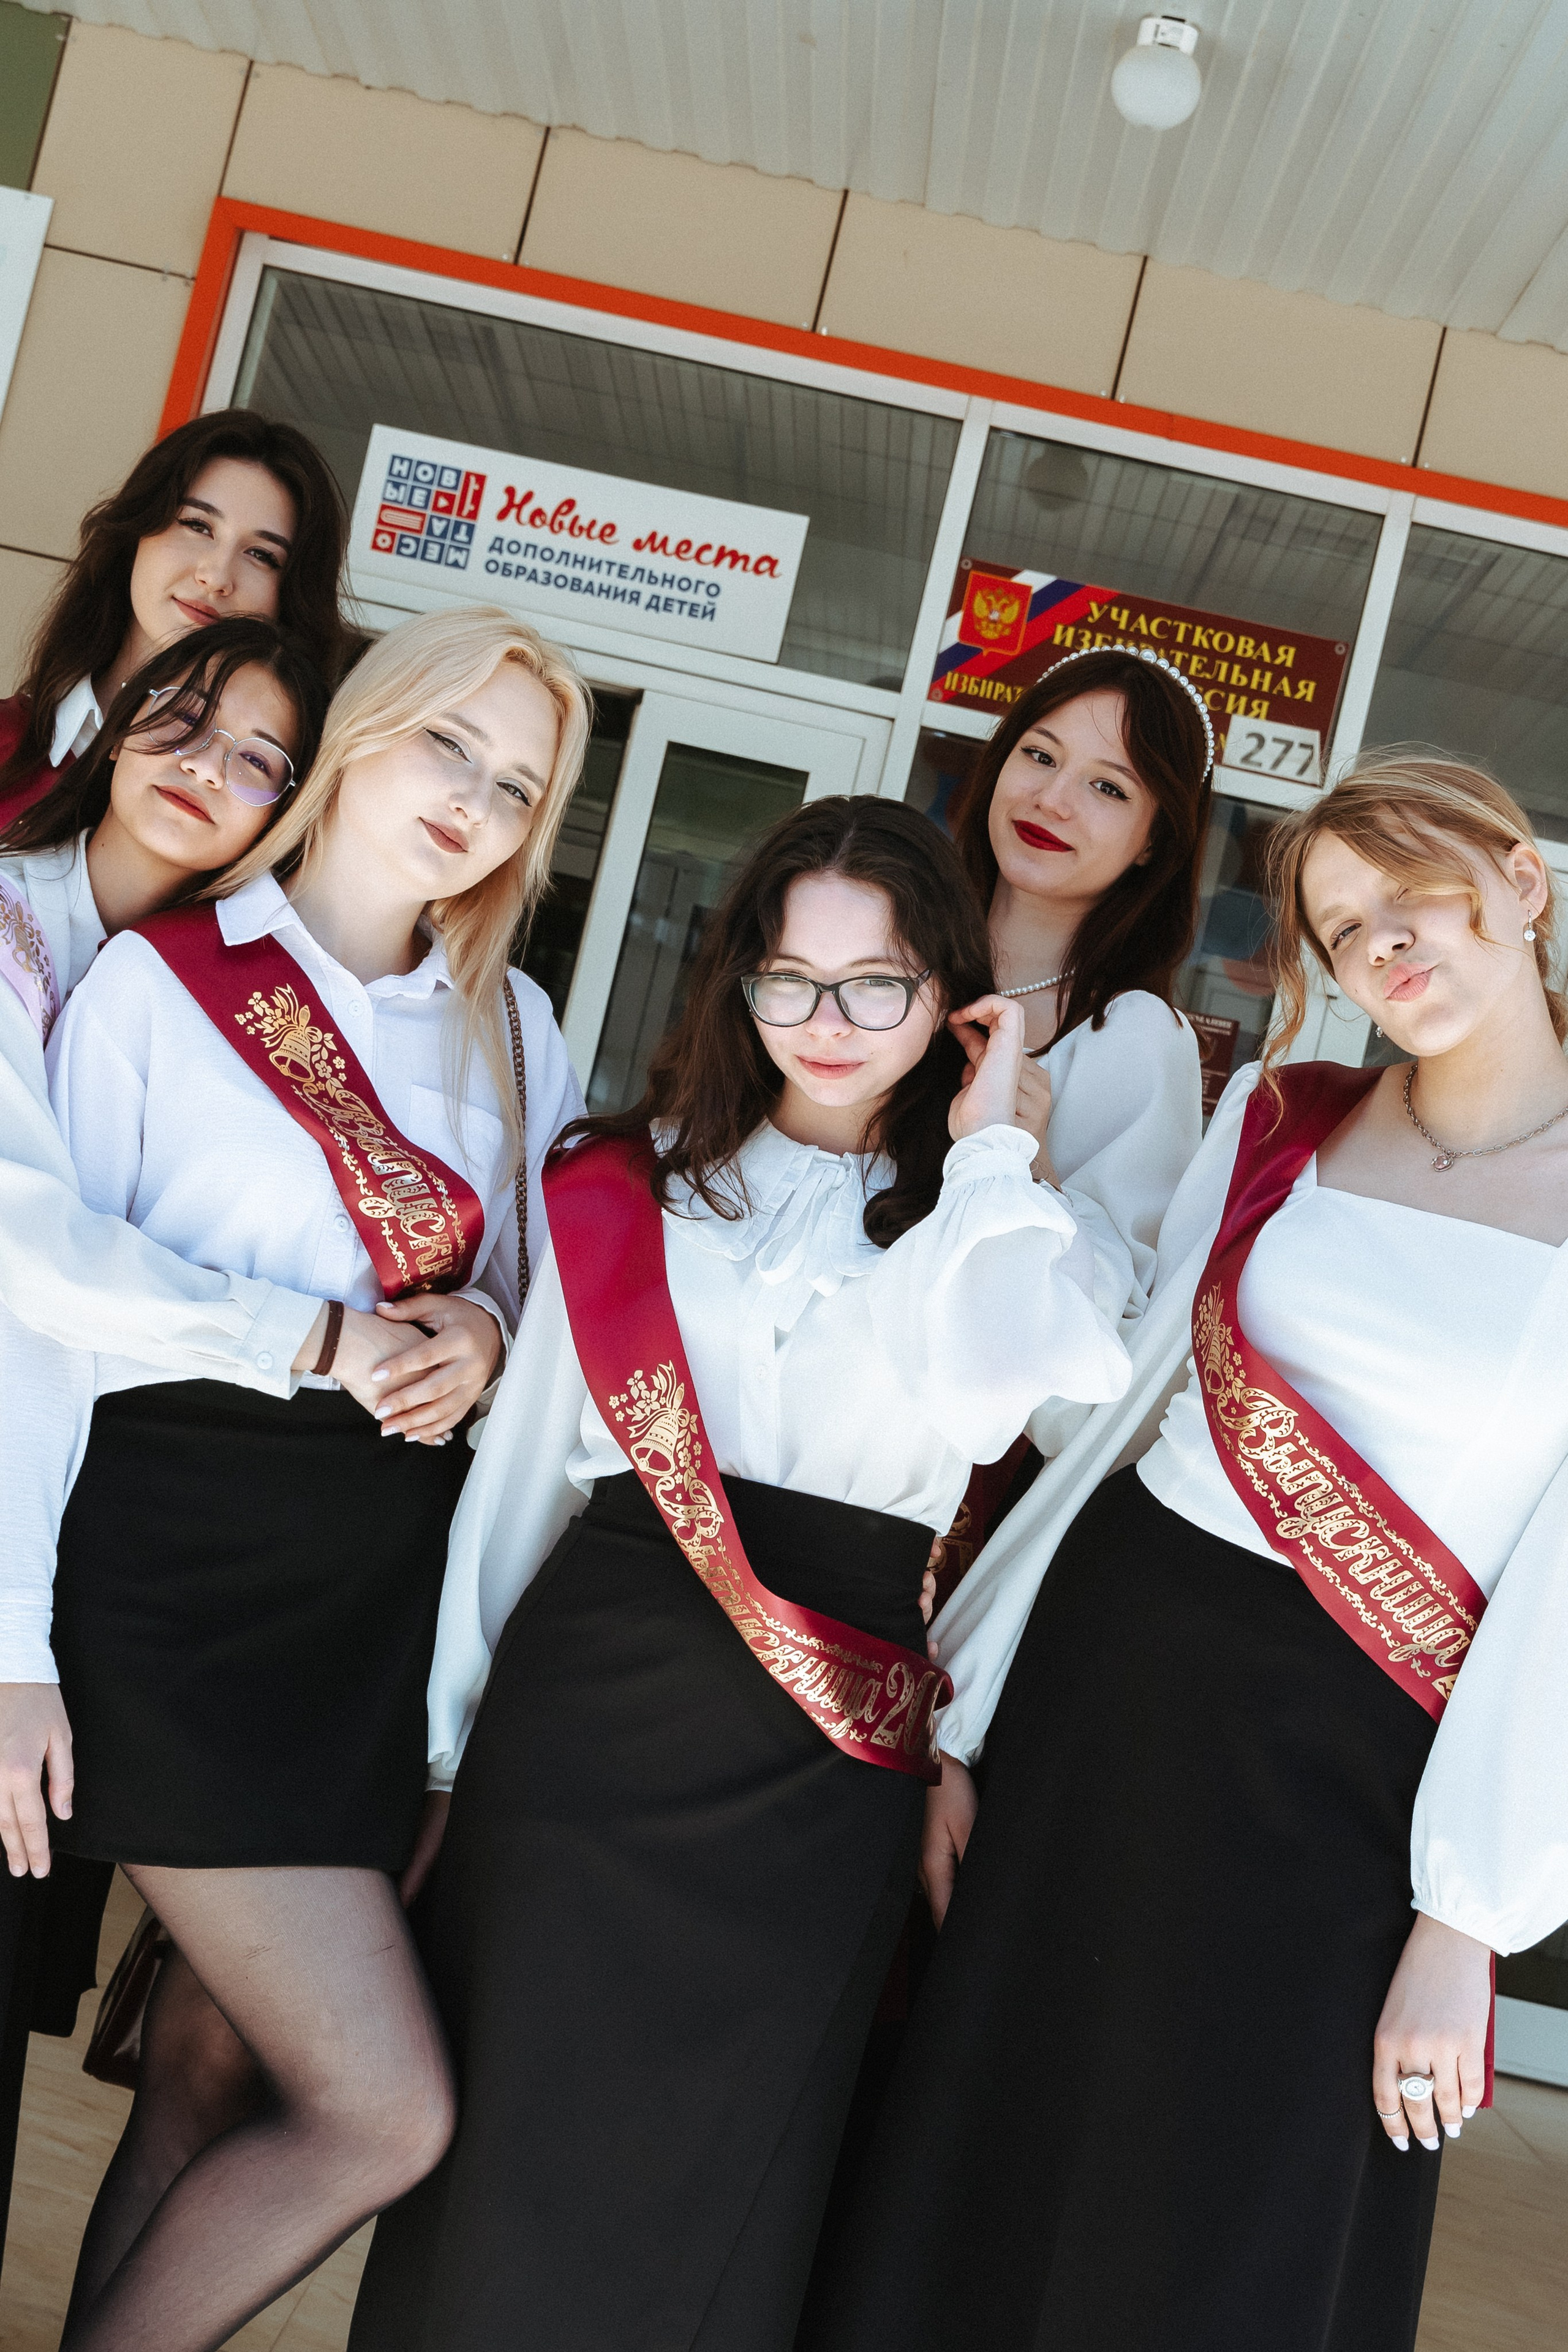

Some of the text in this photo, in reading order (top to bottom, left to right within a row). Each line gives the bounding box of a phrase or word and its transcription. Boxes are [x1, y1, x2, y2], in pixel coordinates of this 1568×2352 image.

[383, 481, 428, 508] ЫЕ
[390, 458, 458, 488] НОВ
[496, 486, 783, 579] Новые места
[484, 559, 717, 622] ОБРАЗОВАНИЯ ДЕТЕЙ
[488, 537, 721, 598] ДОПОЛНИТЕЛЬНОГО
[1087, 601, 1297, 668] УЧАСТКОВАЯ
[1240, 733, 1314, 777] 277
